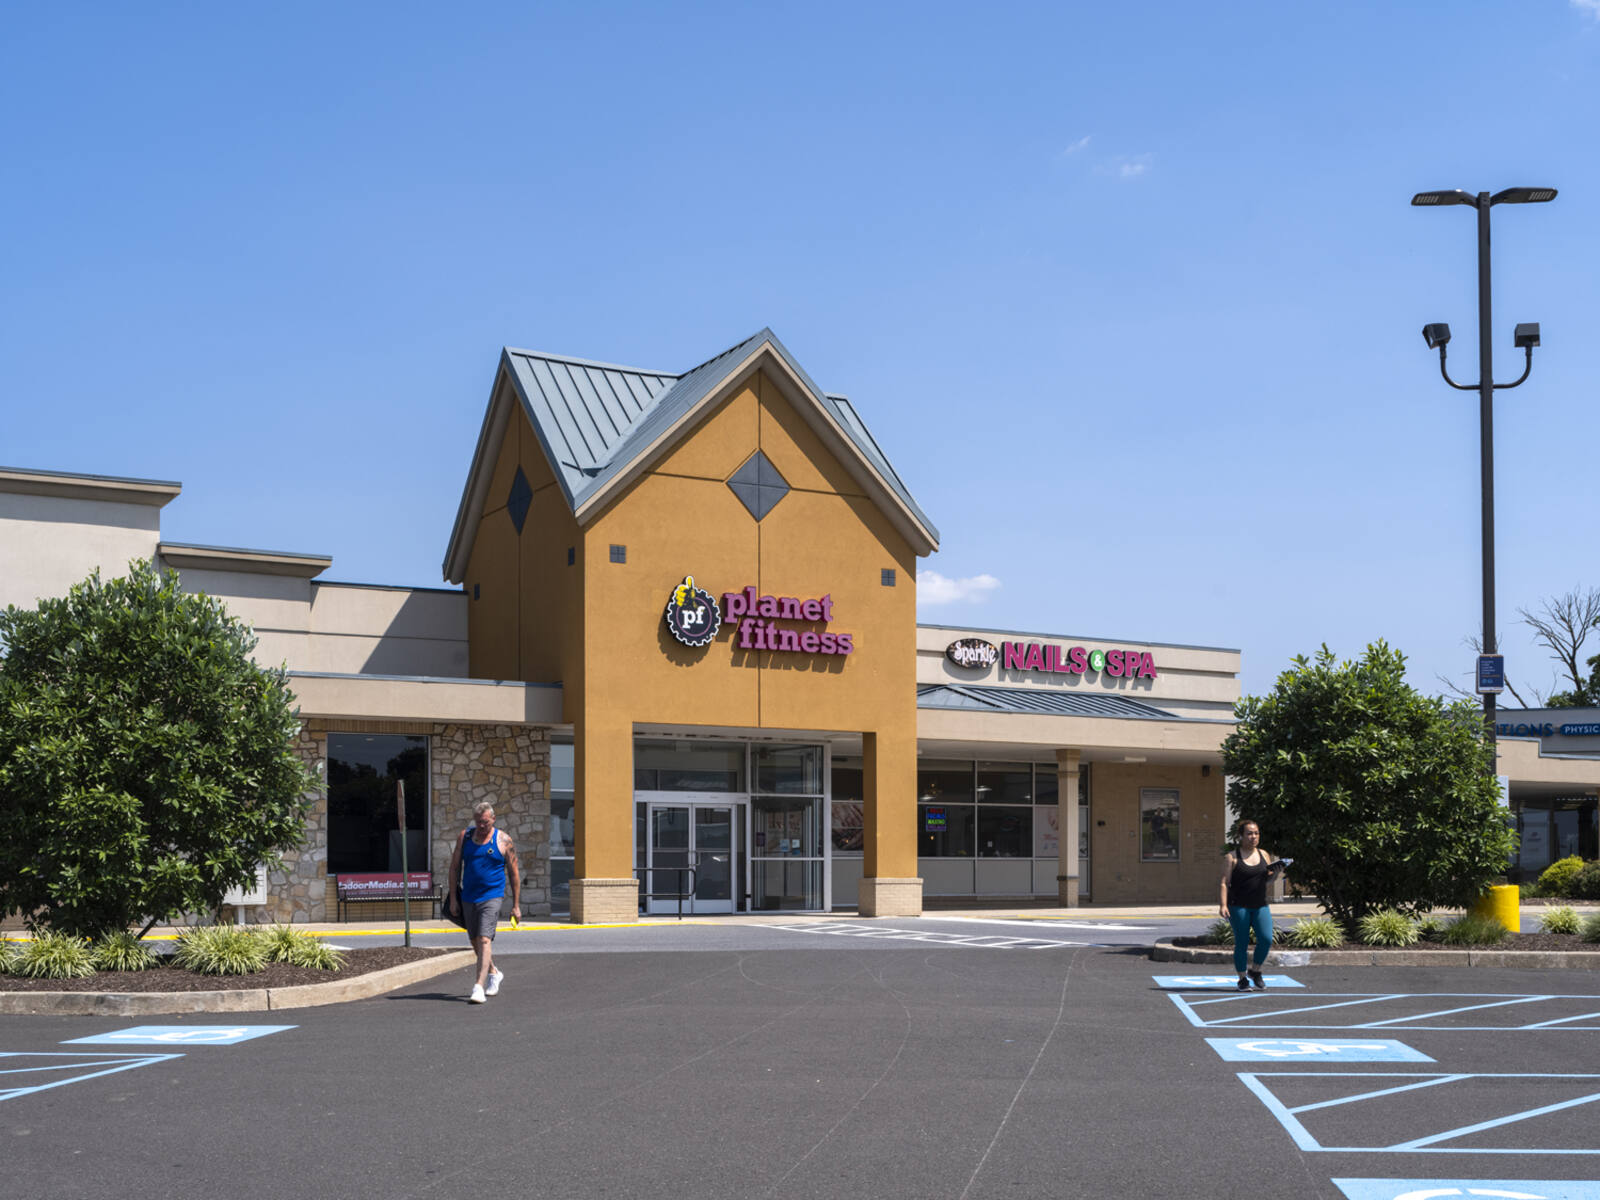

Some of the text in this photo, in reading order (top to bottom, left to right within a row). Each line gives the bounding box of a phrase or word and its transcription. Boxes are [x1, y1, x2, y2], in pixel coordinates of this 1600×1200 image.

[682, 606, 705, 628] pf
[723, 586, 834, 623] planet
[739, 619, 854, 655] fitness
[954, 641, 996, 665] Sparkle
[1004, 642, 1087, 673] NAILS
[1107, 650, 1157, 678] SPA
